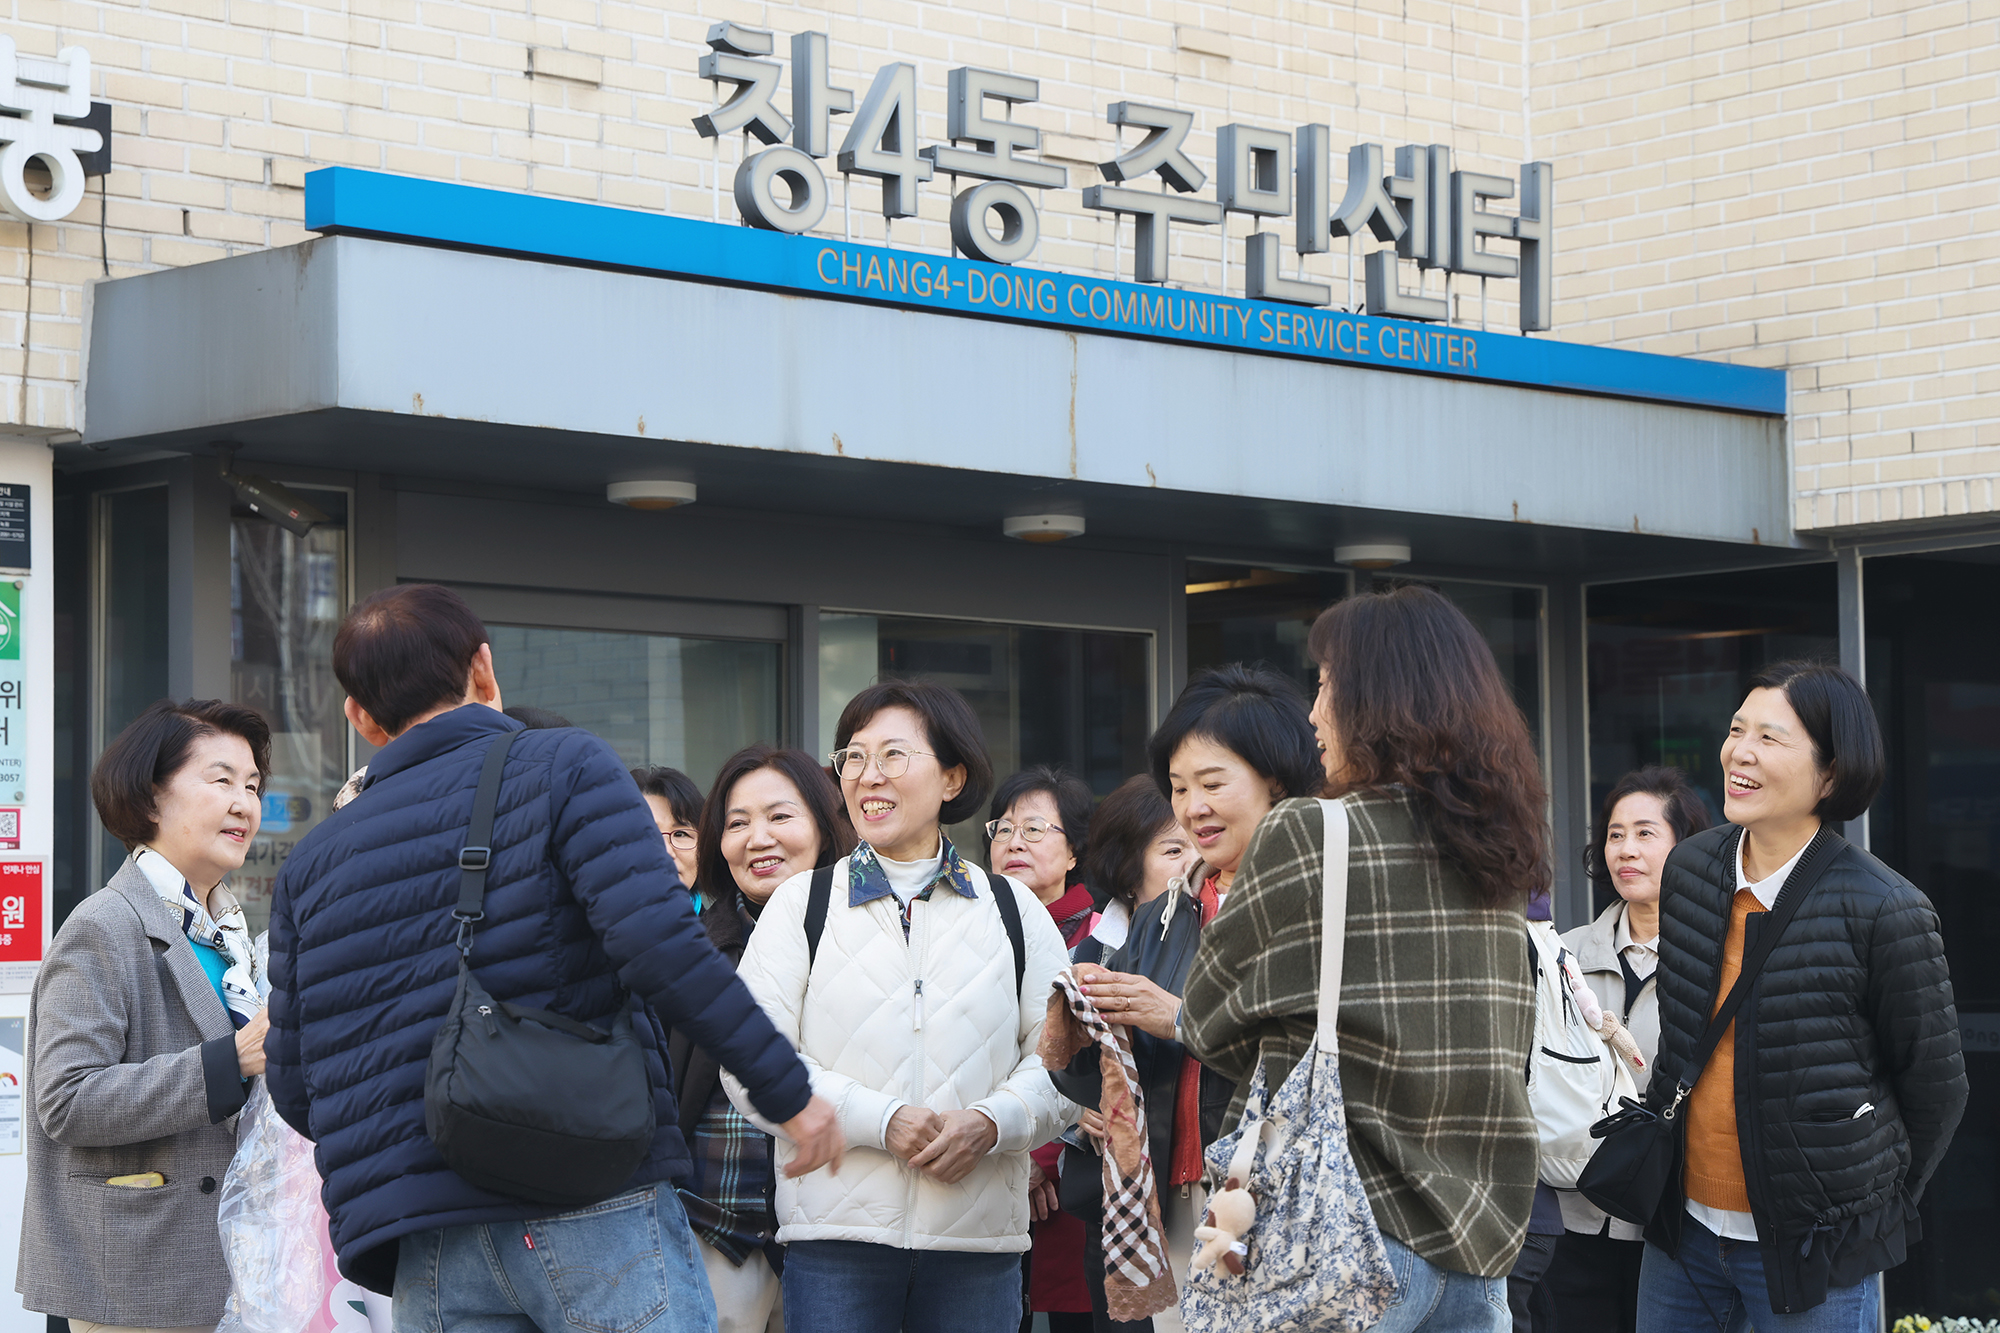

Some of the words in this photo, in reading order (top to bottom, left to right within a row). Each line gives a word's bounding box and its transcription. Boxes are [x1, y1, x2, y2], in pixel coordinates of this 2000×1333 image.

[1081, 100, 1553, 332] 주민센터
[816, 247, 1058, 314] CHANG4-DONG
[1067, 283, 1253, 339] COMMUNITY
[1258, 309, 1370, 355] SERVICE
[1378, 325, 1478, 369] CENTER
[2, 896, 25, 929] 원
